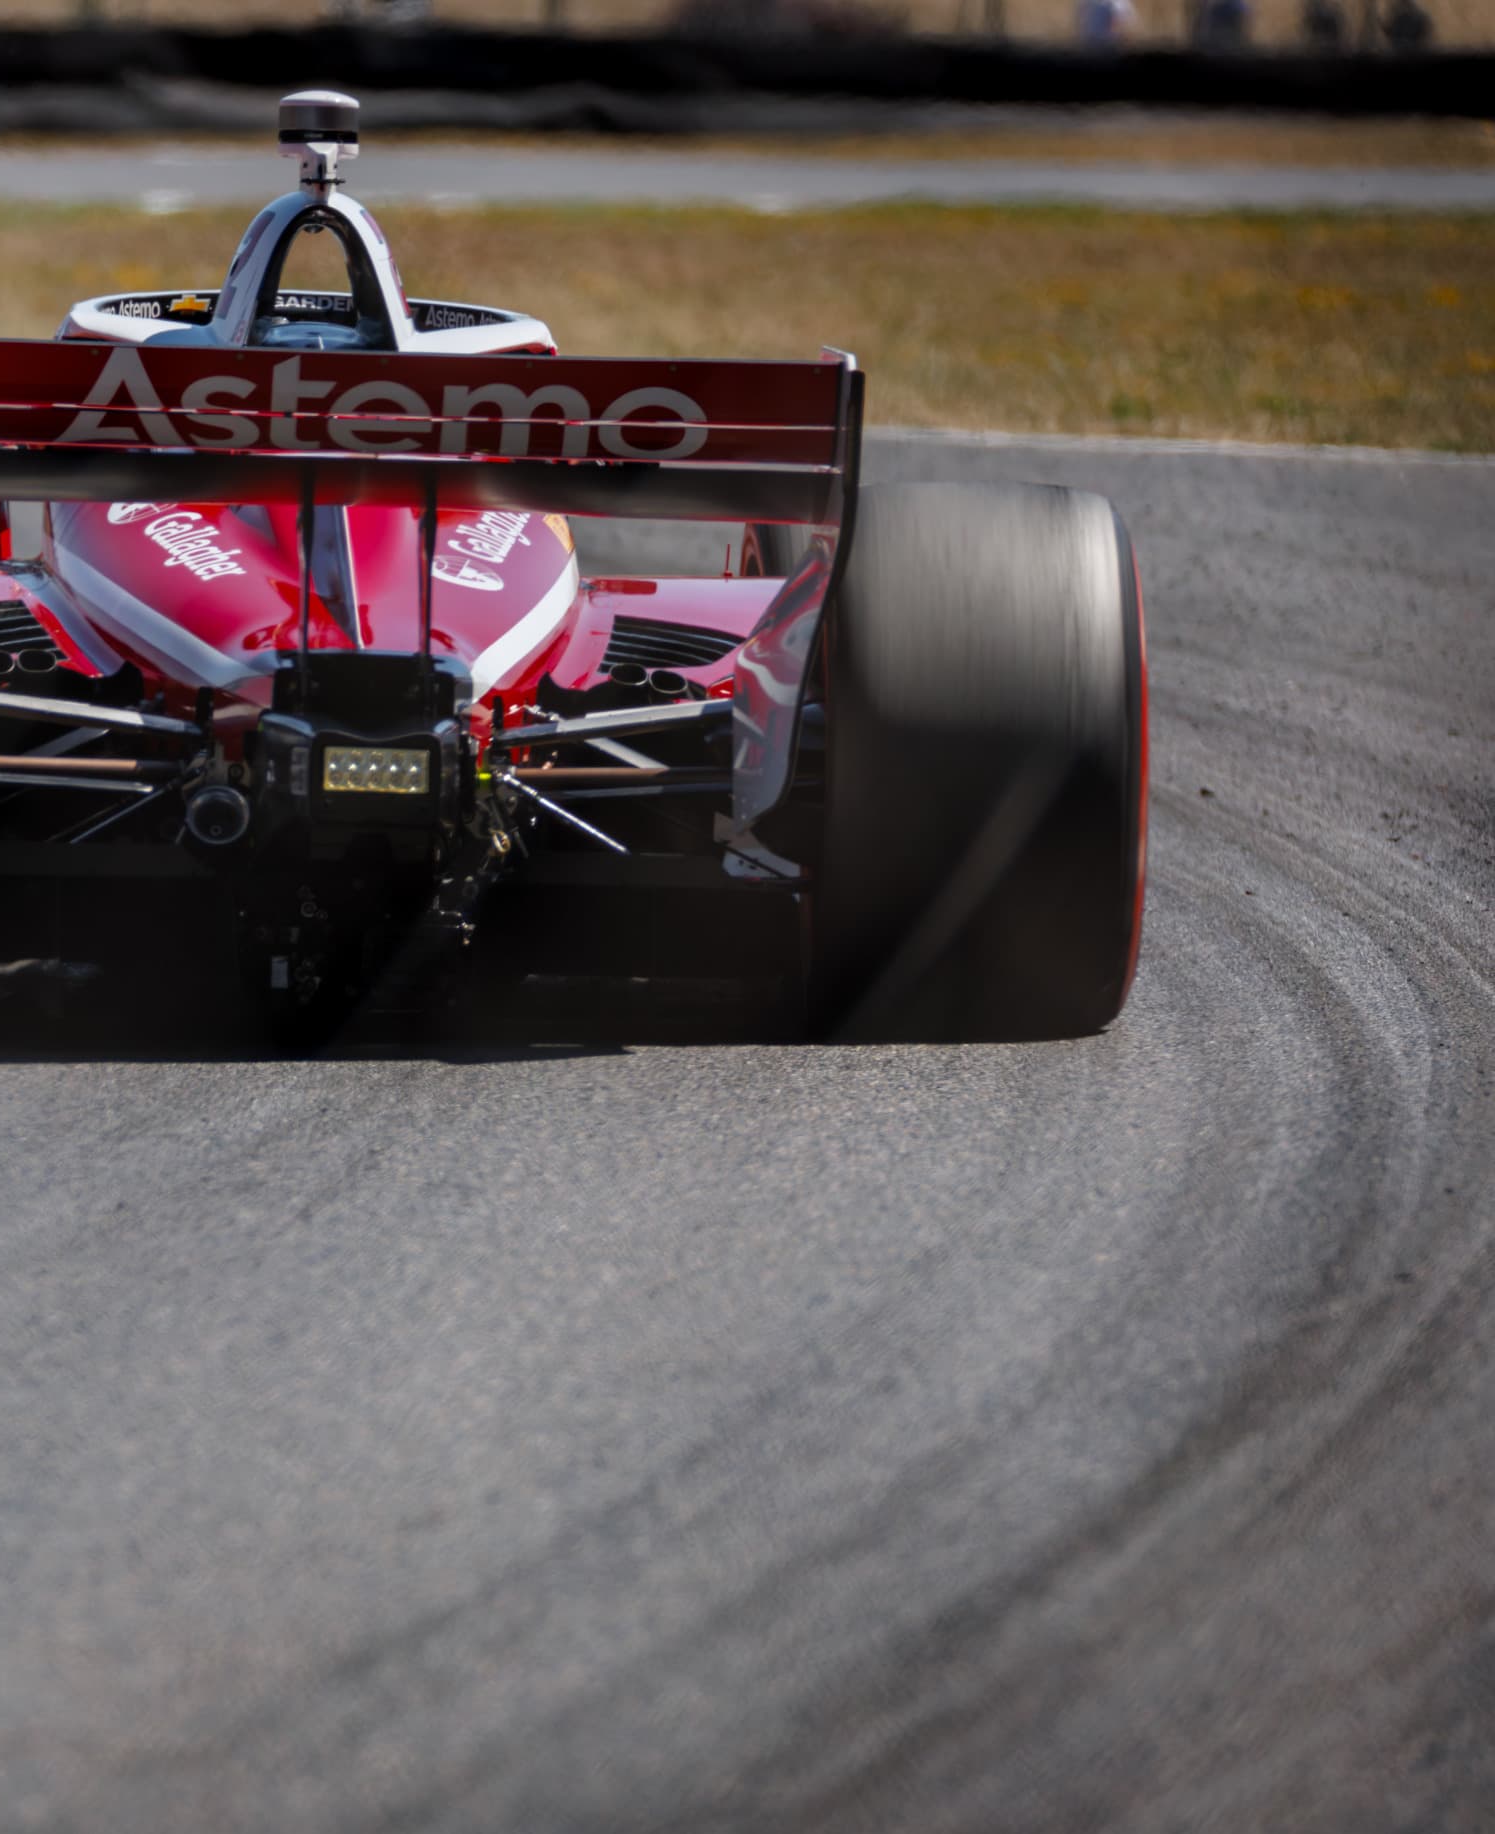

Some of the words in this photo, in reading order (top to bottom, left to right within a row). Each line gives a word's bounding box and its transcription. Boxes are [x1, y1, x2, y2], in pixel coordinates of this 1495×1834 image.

[118, 298, 161, 319] Astemo
[424, 304, 475, 329] Astemo
[55, 346, 709, 460] Astemo
[144, 511, 247, 581] Gallagher
